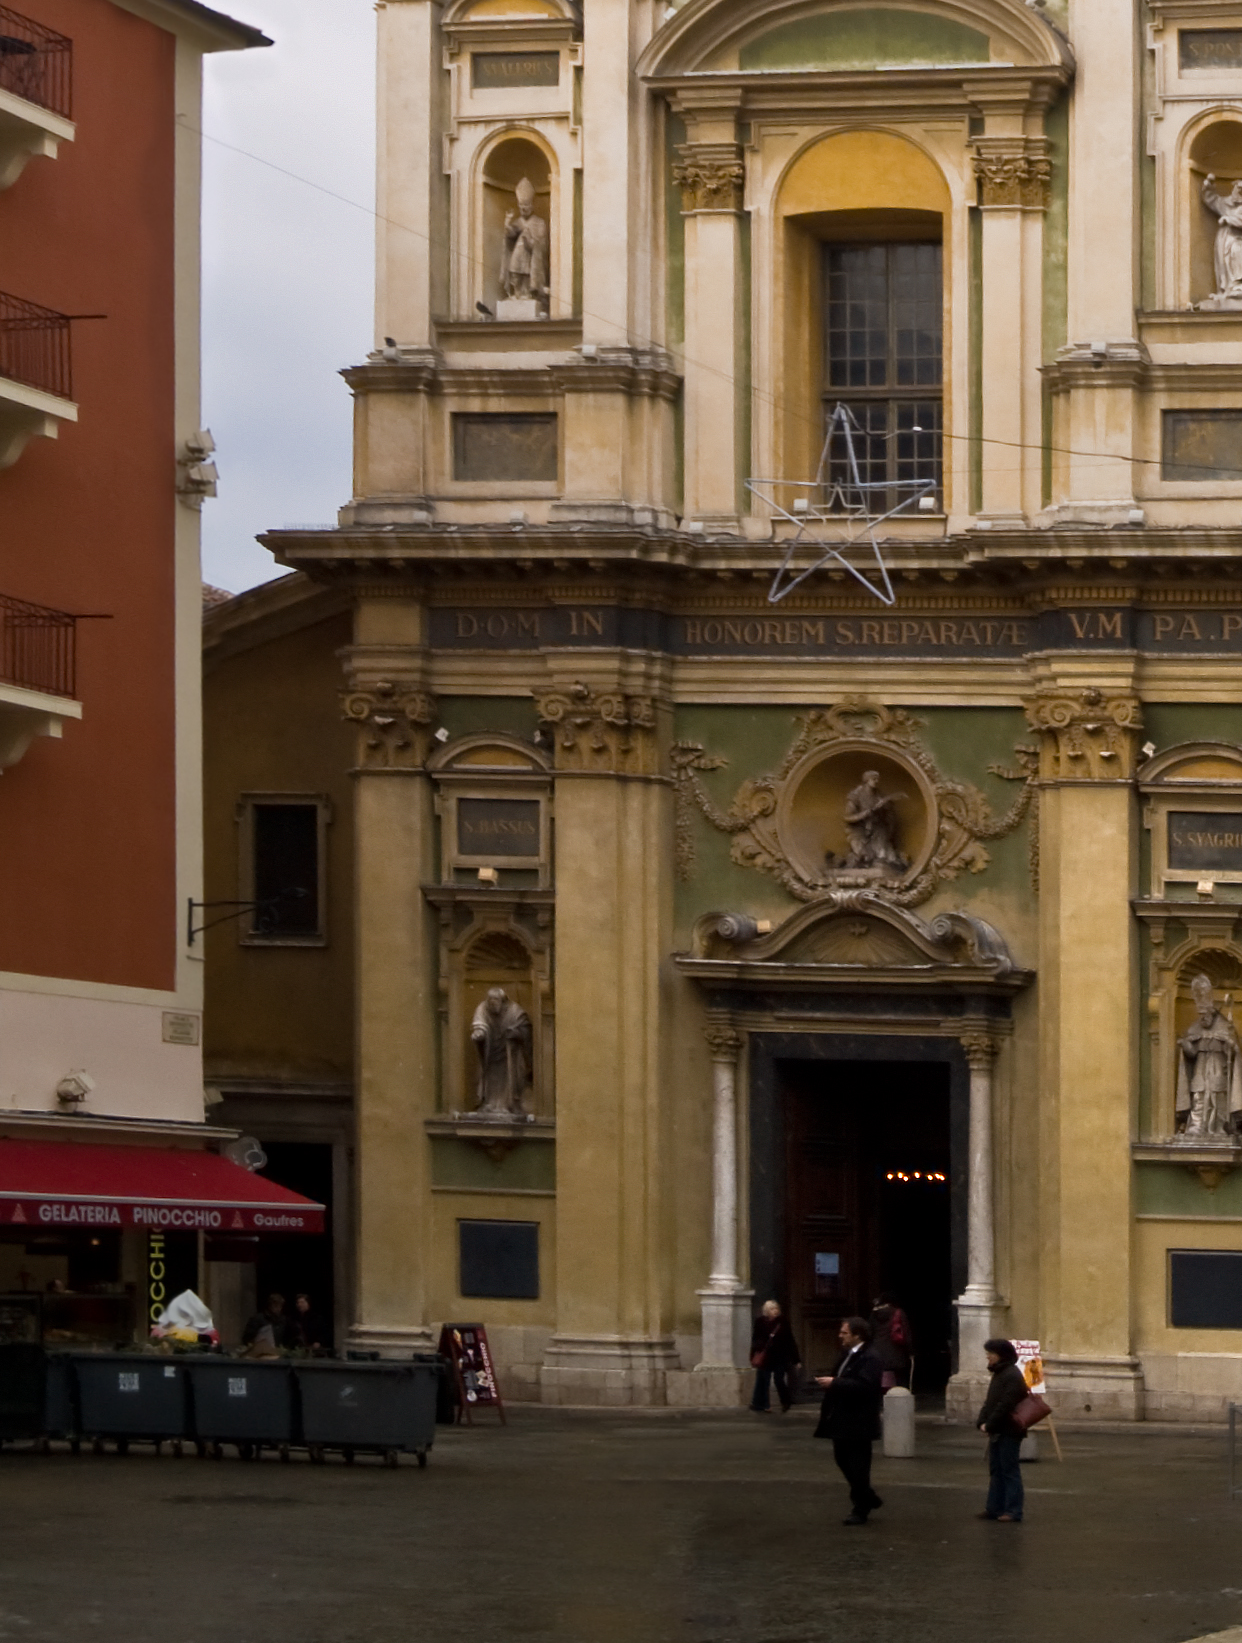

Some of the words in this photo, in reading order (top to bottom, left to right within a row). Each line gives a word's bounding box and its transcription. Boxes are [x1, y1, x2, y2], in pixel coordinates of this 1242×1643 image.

[569, 611, 605, 637] IN
[685, 620, 826, 645] HONOREM
[38, 1204, 121, 1224] GELATERIA
[133, 1206, 221, 1227] PINOCCHIO
[253, 1213, 304, 1227] Gaufres
